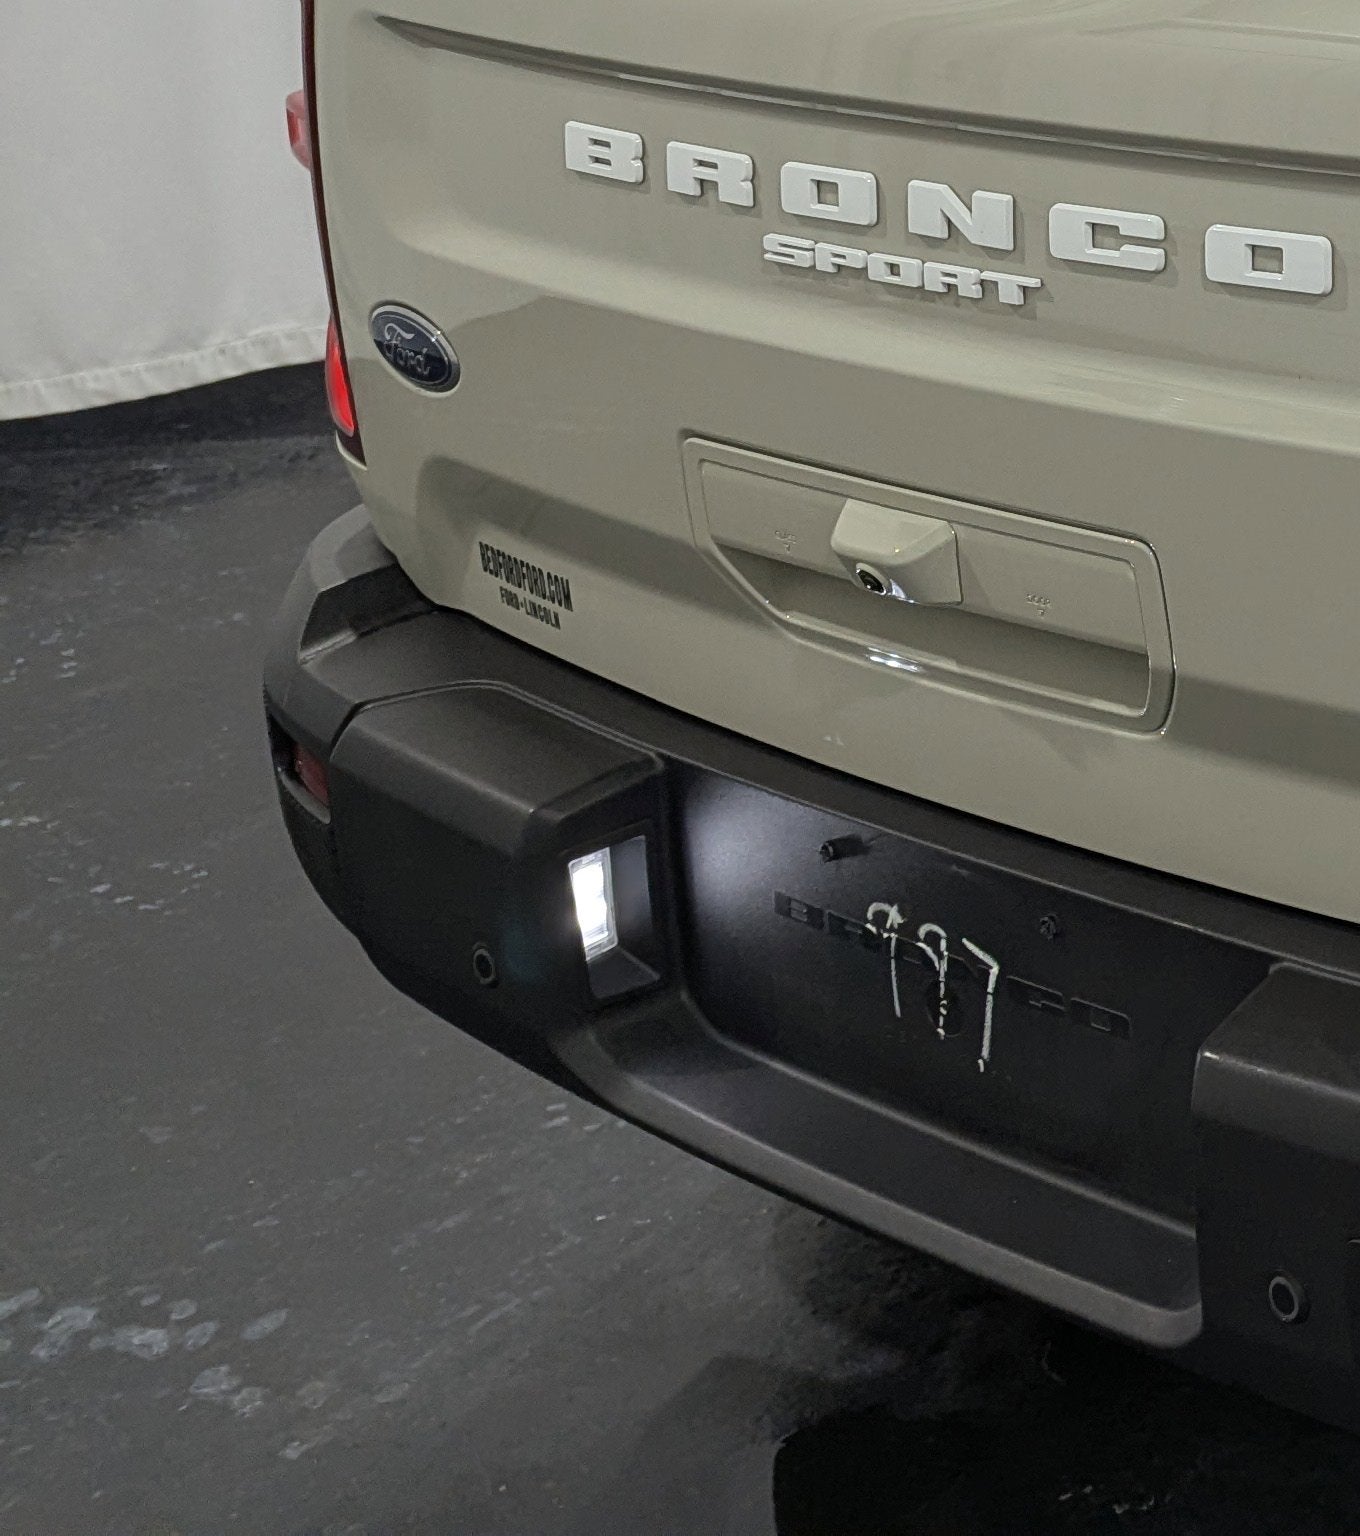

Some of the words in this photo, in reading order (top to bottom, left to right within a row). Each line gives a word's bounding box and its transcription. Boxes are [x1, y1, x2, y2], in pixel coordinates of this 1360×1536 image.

[565, 120, 1334, 295] BRONCO
[762, 232, 1042, 306] SPORT
[383, 322, 431, 376] Ford
[479, 541, 574, 613] BEDFORDFORD.COM
